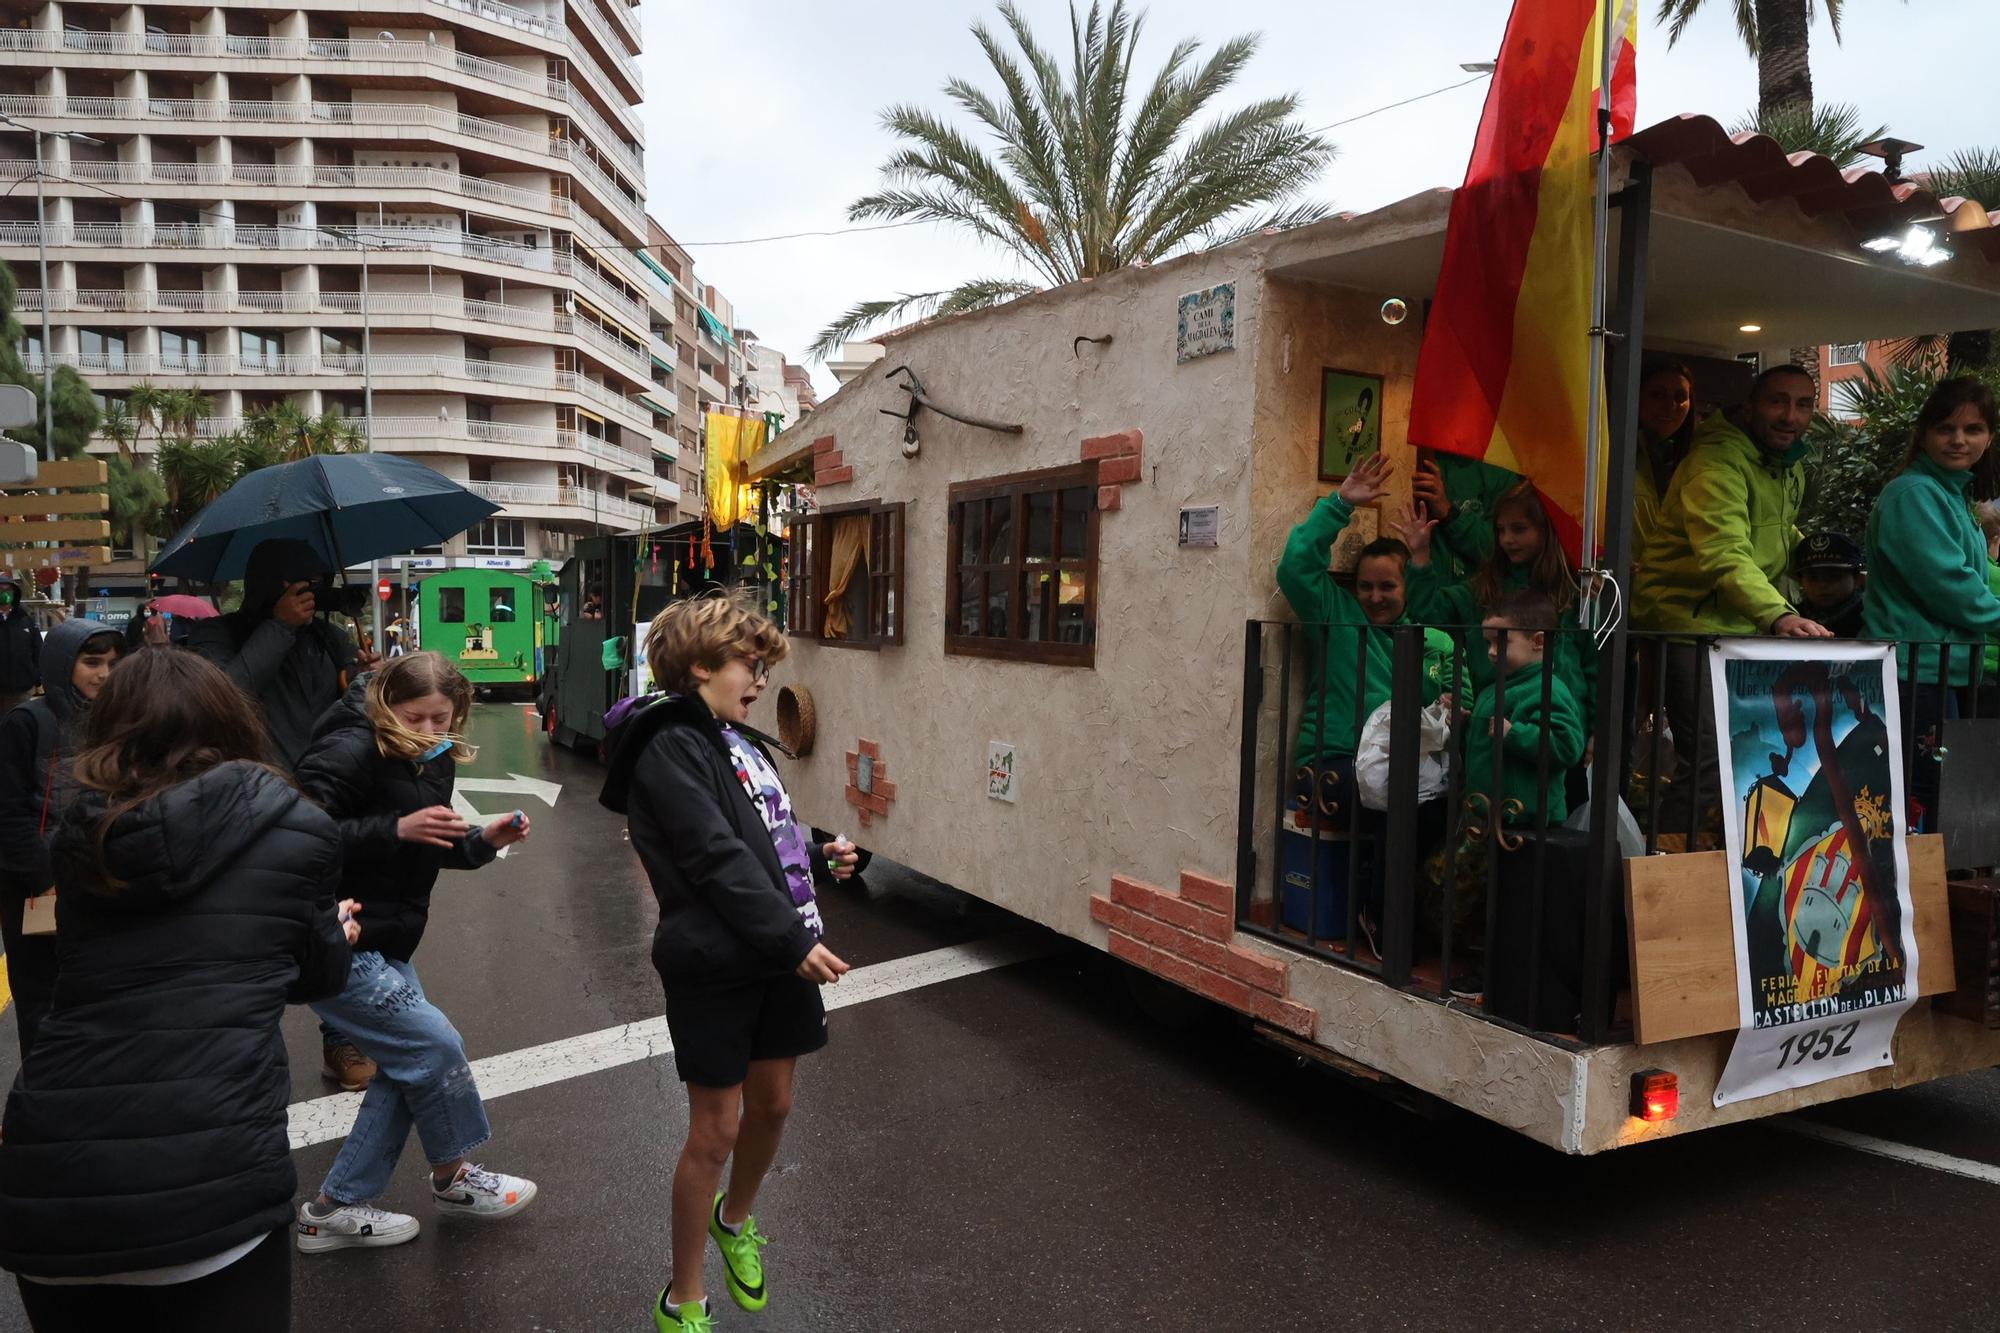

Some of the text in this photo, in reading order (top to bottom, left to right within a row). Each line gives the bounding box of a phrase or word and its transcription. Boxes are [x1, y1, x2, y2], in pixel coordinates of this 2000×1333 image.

[1193, 309, 1214, 322] CAMI
[1187, 326, 1222, 342] MAGDALENA
[1761, 957, 1900, 992] FERIA FITAS DE LA
[1754, 984, 1907, 1029] CASTELLON DE LA PLANA
[1776, 1020, 1860, 1069] 1952
